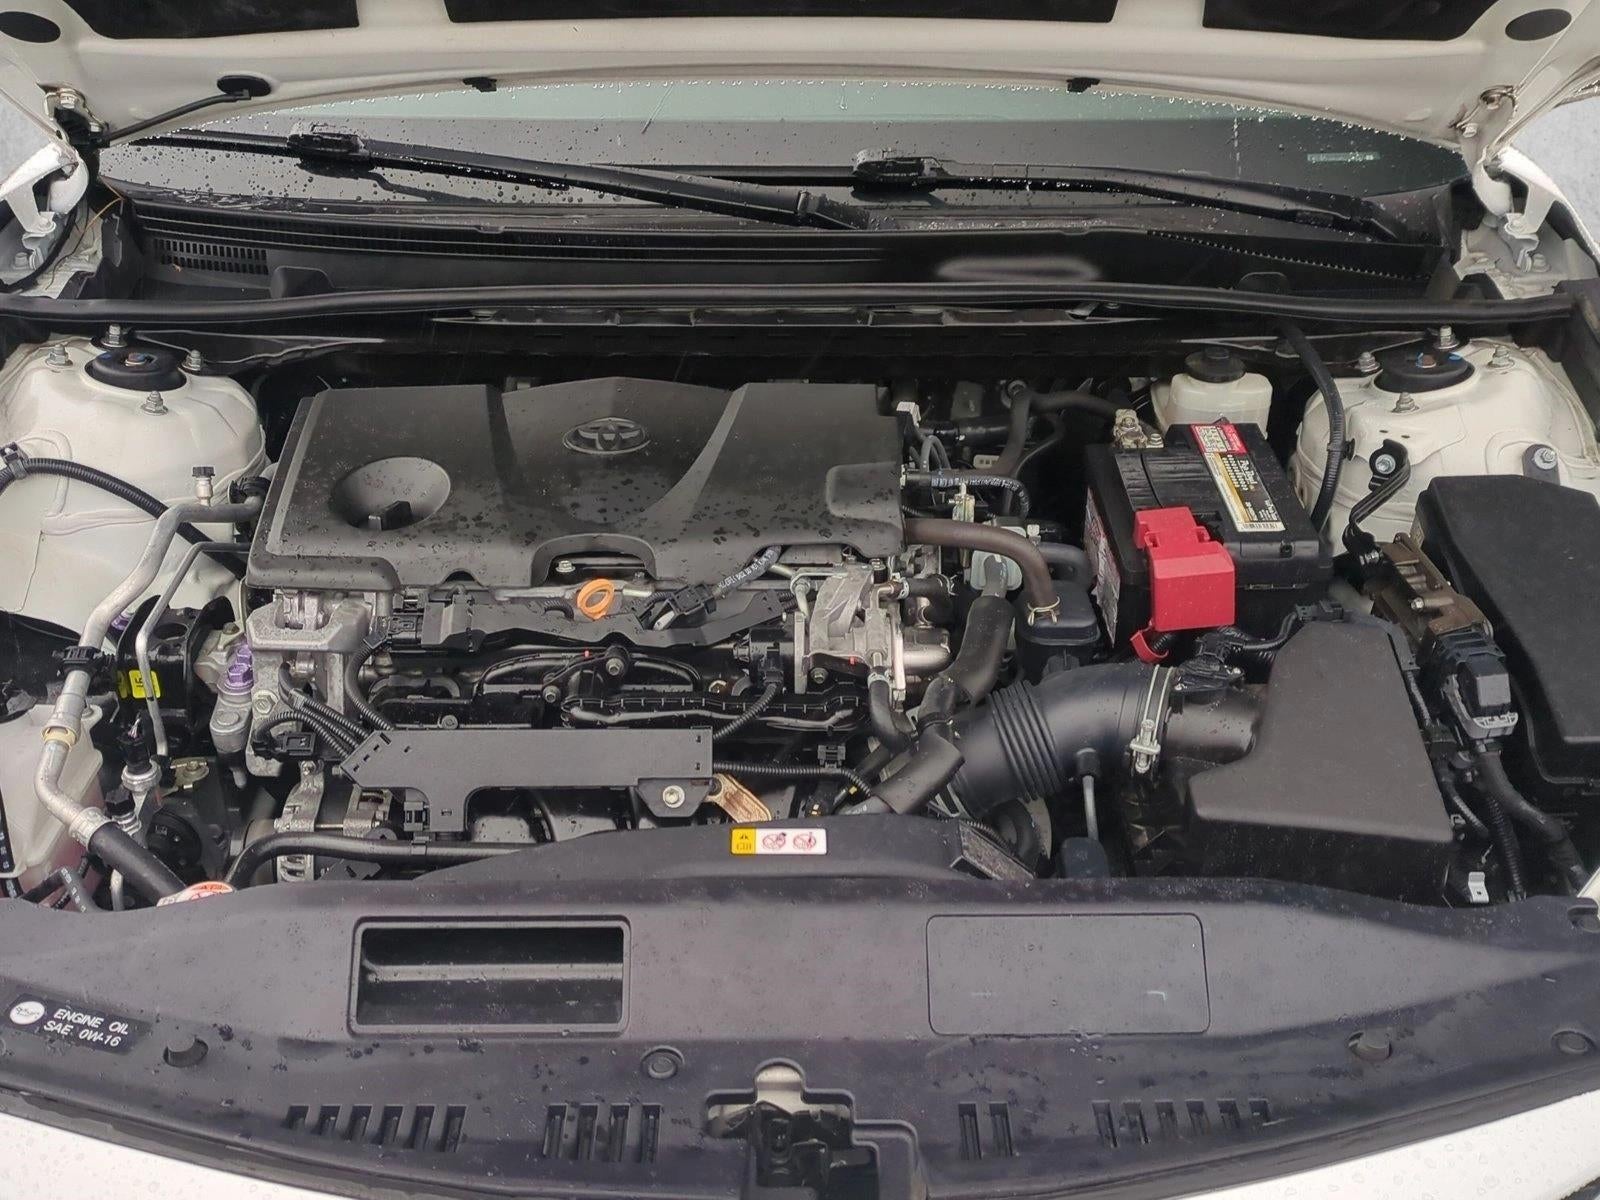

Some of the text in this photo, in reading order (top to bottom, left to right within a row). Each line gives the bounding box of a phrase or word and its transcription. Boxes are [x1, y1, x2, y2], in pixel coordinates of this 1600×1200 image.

[43, 1020, 122, 1047] SAE 0W-16
[53, 1008, 129, 1035] ENGINE OIL
